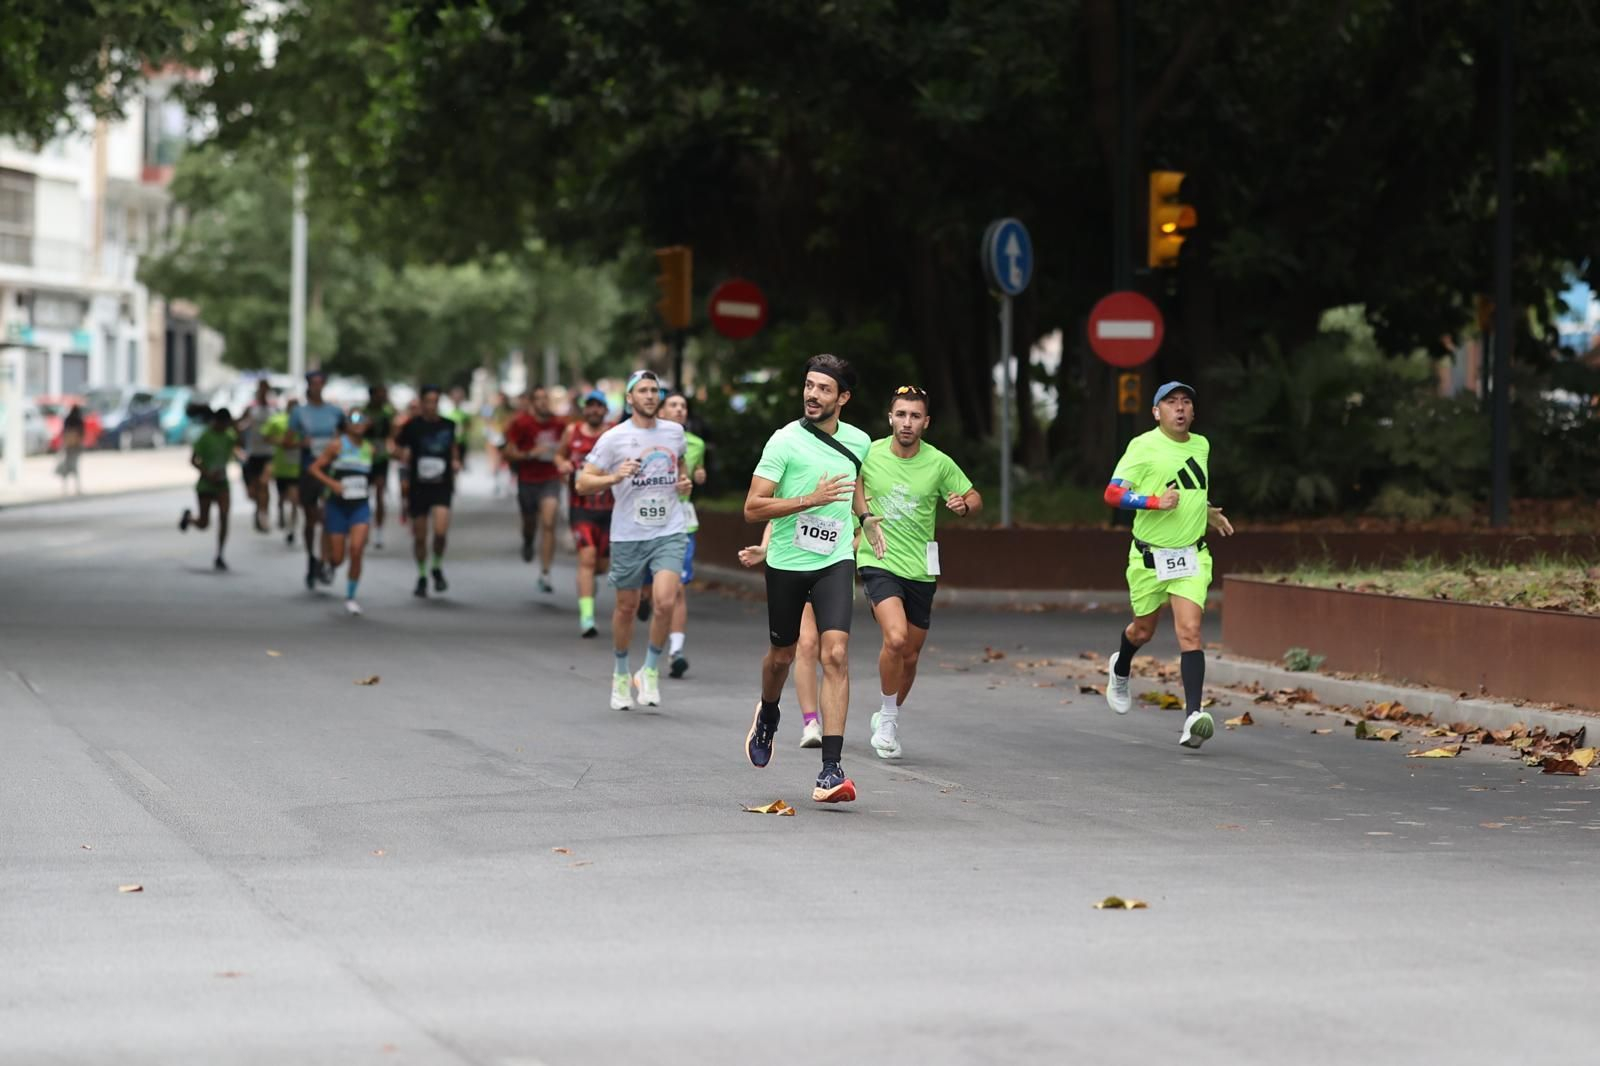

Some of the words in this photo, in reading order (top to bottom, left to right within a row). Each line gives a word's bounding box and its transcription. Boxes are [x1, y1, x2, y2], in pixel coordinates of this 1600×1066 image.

[640, 506, 666, 517] 699
[800, 525, 837, 542] 1092
[1166, 556, 1186, 570] 54
